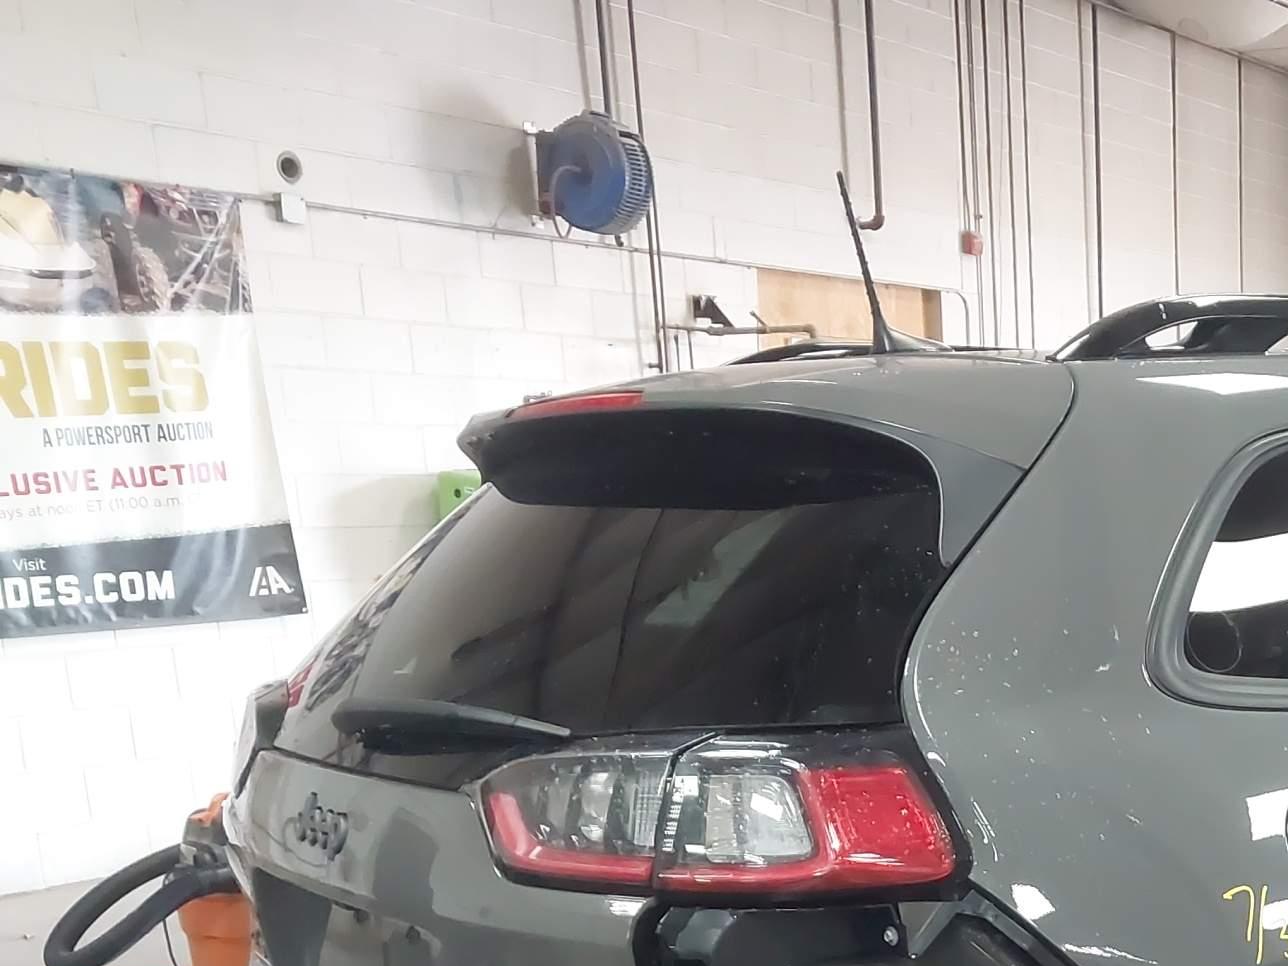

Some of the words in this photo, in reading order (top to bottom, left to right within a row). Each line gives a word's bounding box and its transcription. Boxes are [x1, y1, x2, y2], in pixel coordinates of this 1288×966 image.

[42, 426, 54, 448] A
[55, 422, 151, 447] POWERSPORT
[156, 421, 214, 443] AUCTION
[110, 460, 228, 490] AUCTION
[28, 503, 42, 517] at
[12, 557, 47, 573] Visit
[296, 791, 349, 862] Jeep
